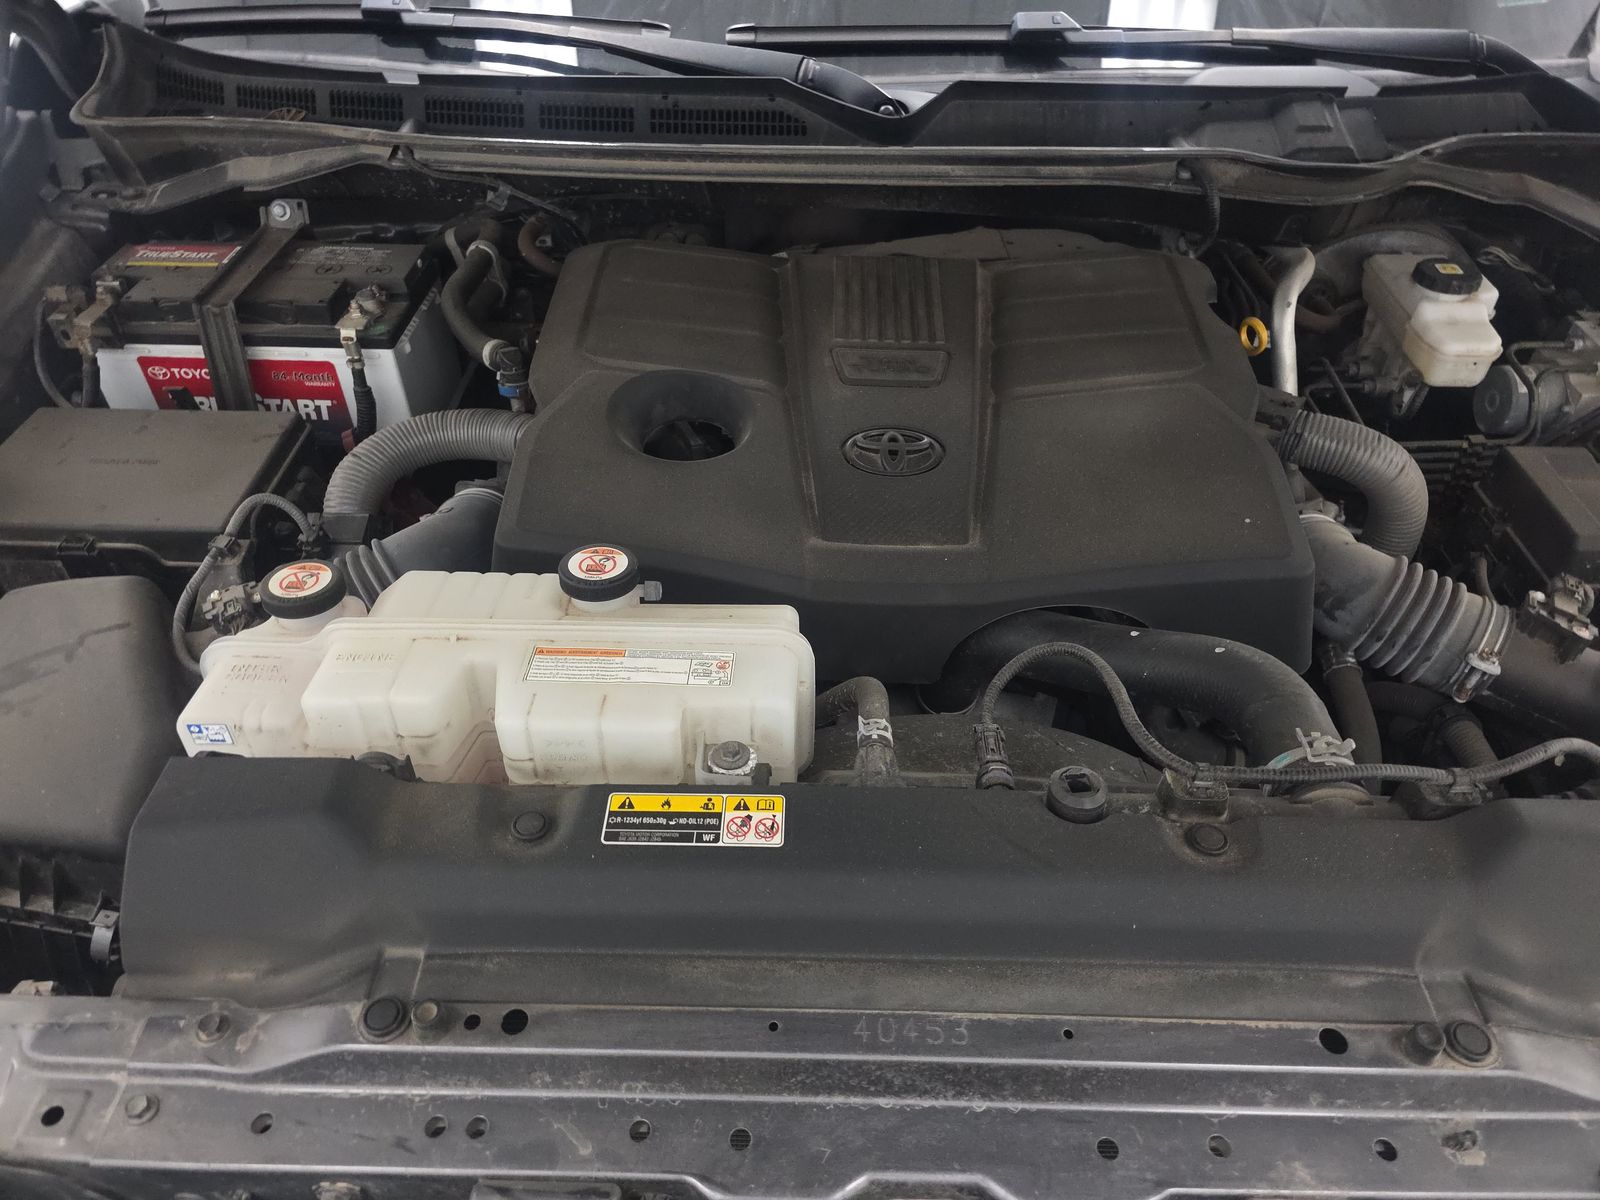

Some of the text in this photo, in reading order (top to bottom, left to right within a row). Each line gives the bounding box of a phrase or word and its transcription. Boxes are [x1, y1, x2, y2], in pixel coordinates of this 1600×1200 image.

[170, 367, 211, 380] TOYO
[702, 833, 716, 842] WF
[853, 1016, 970, 1046] 40453
